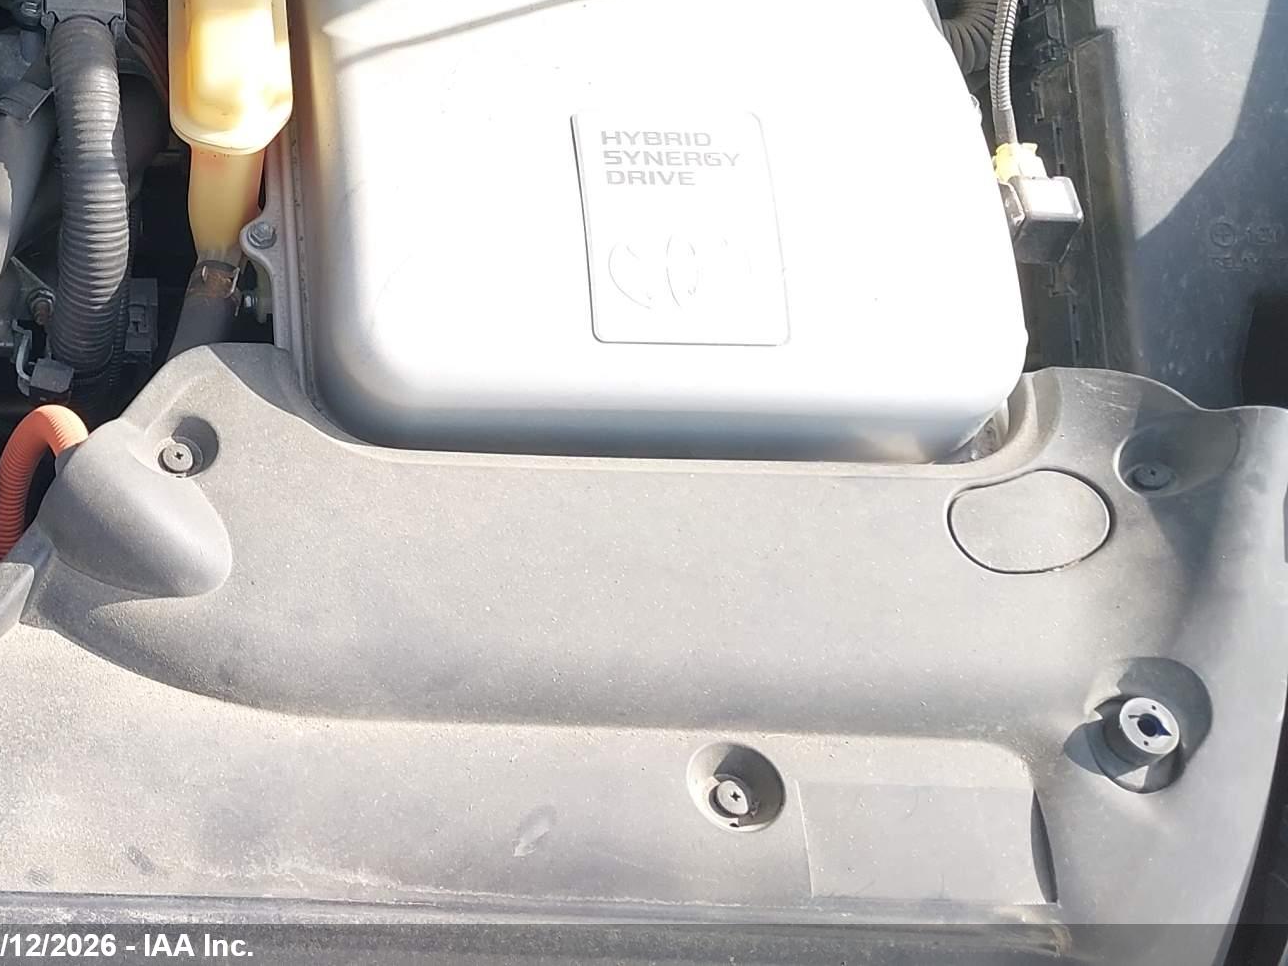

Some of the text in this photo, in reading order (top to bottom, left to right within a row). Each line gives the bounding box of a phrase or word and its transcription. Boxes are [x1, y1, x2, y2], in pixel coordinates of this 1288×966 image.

[601, 130, 712, 147] HYBRID
[603, 150, 740, 167] SYNERGY
[606, 170, 696, 186] DRIVE
